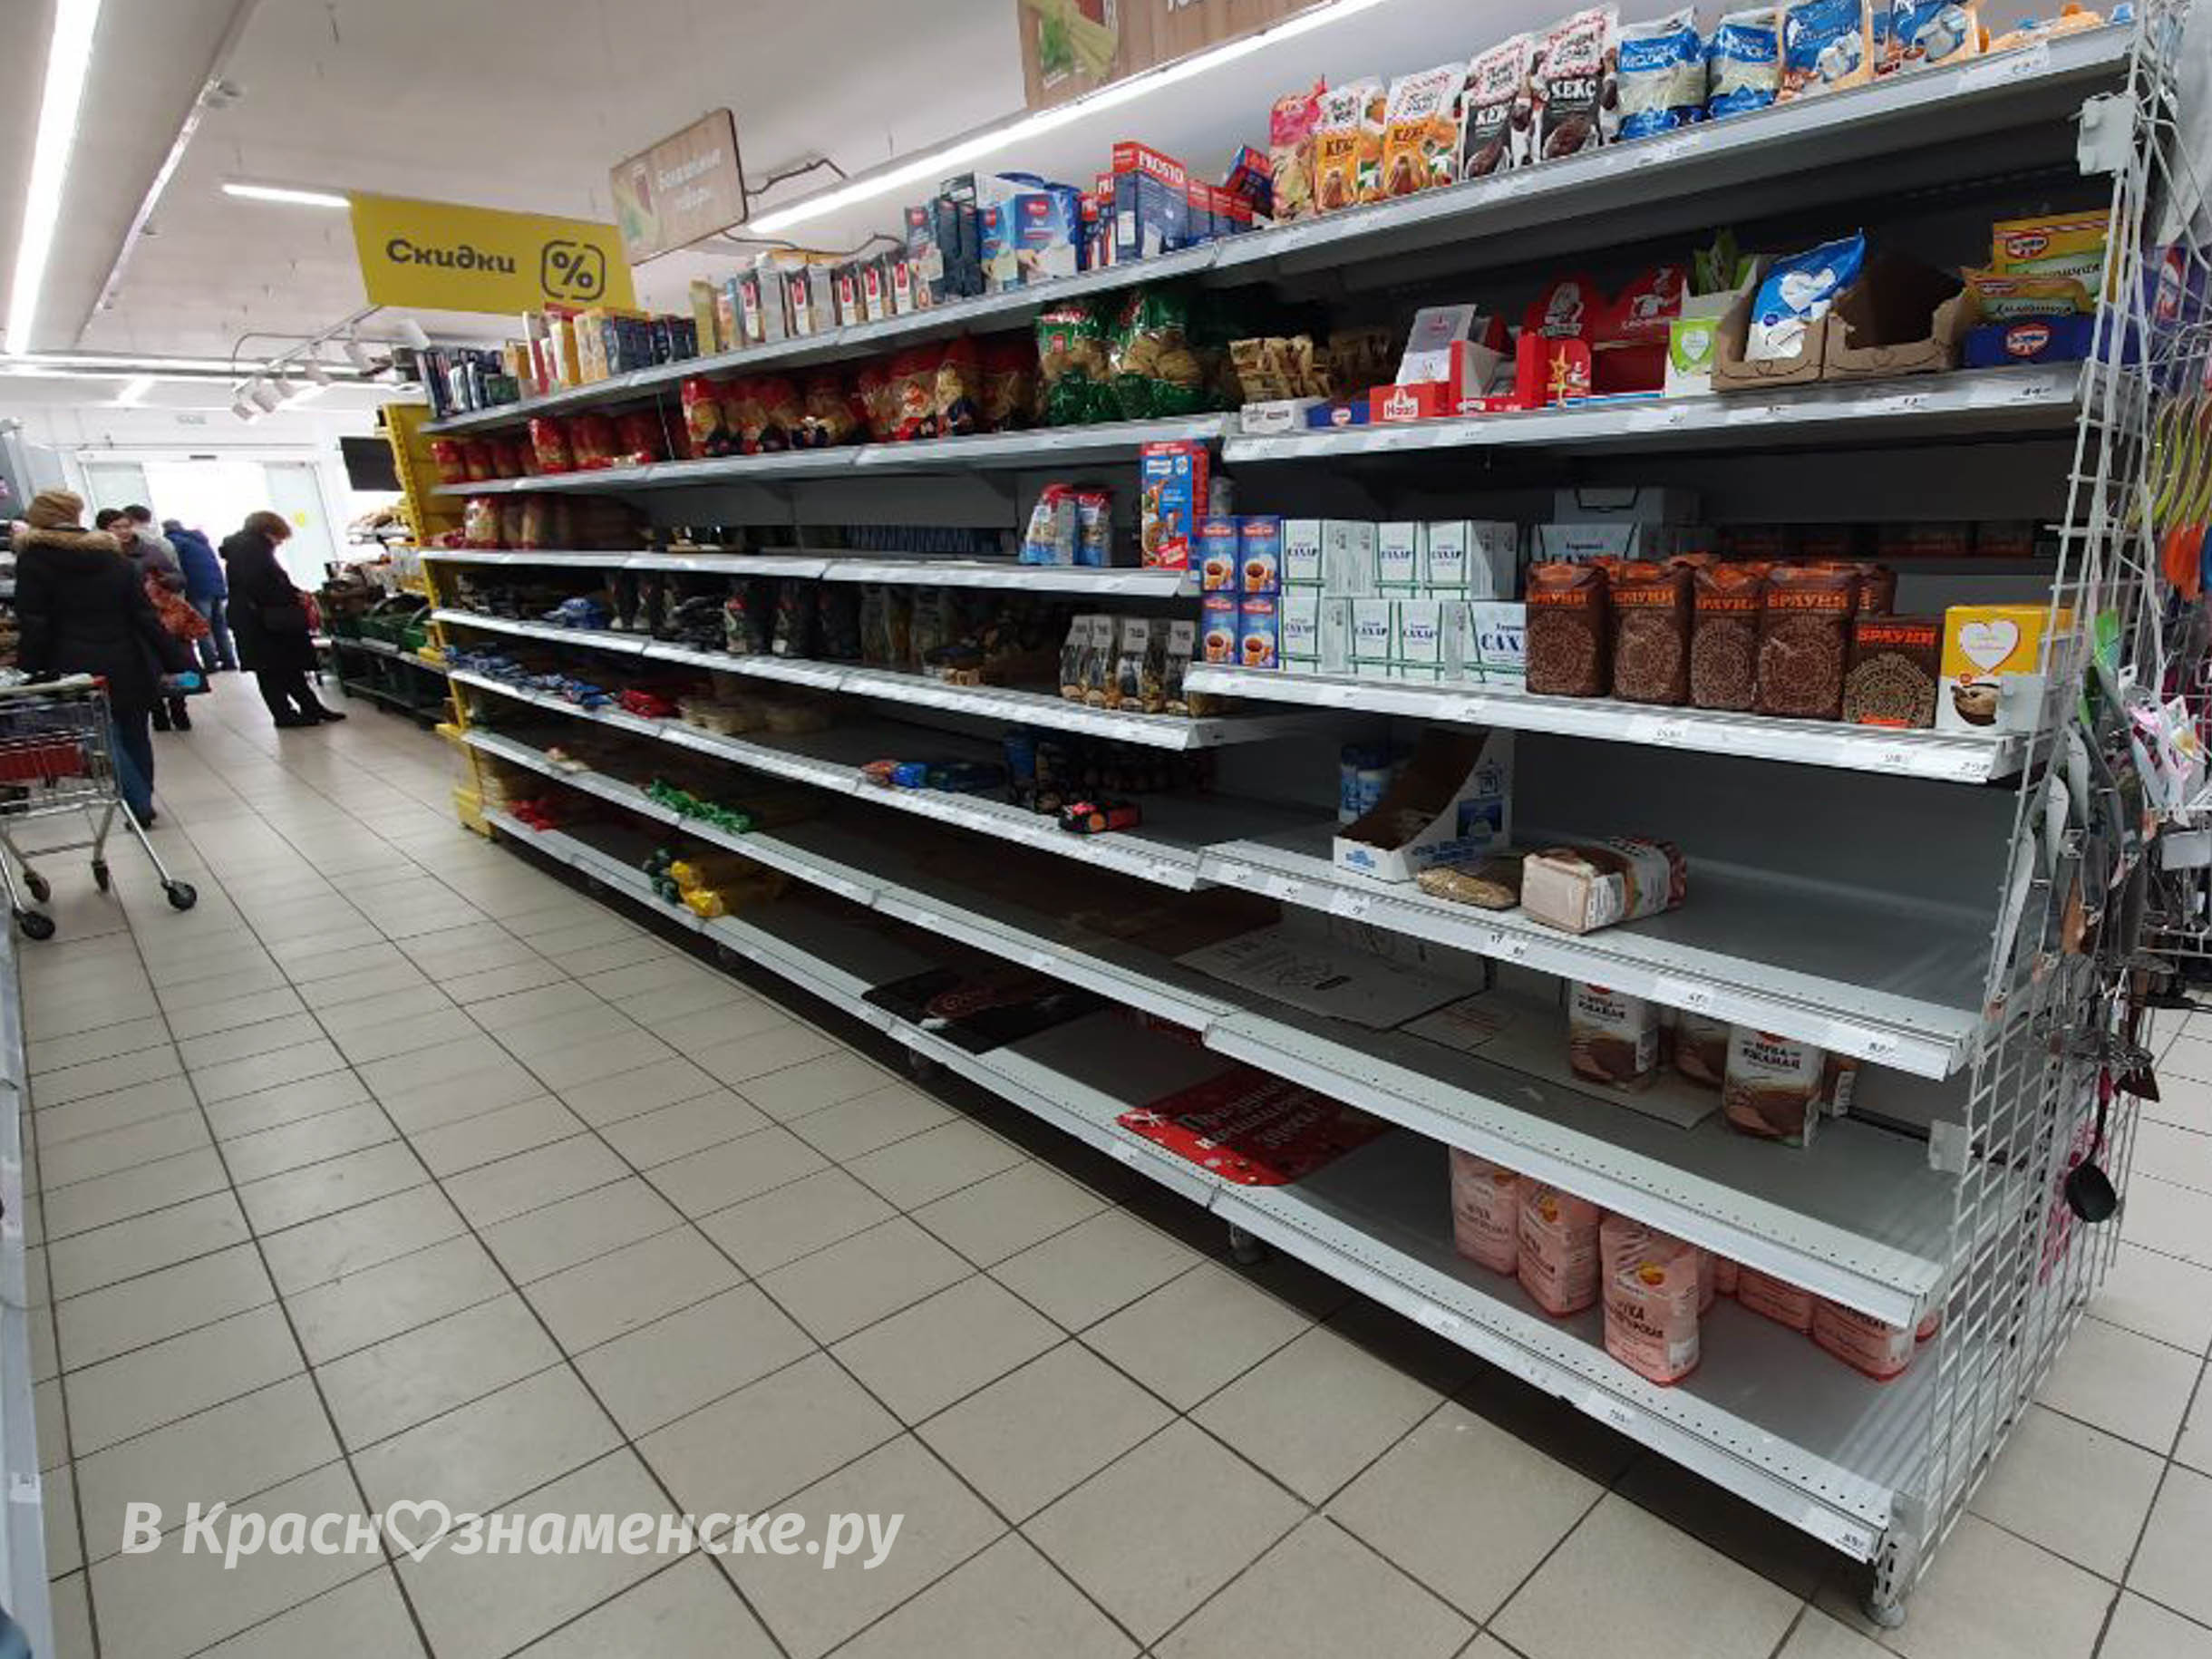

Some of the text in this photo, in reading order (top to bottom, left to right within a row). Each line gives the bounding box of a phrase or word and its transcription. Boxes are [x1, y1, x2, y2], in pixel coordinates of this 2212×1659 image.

[1550, 79, 1598, 100] КЕКС
[386, 238, 517, 275] Скидки
[1480, 632, 1520, 652] САХ
